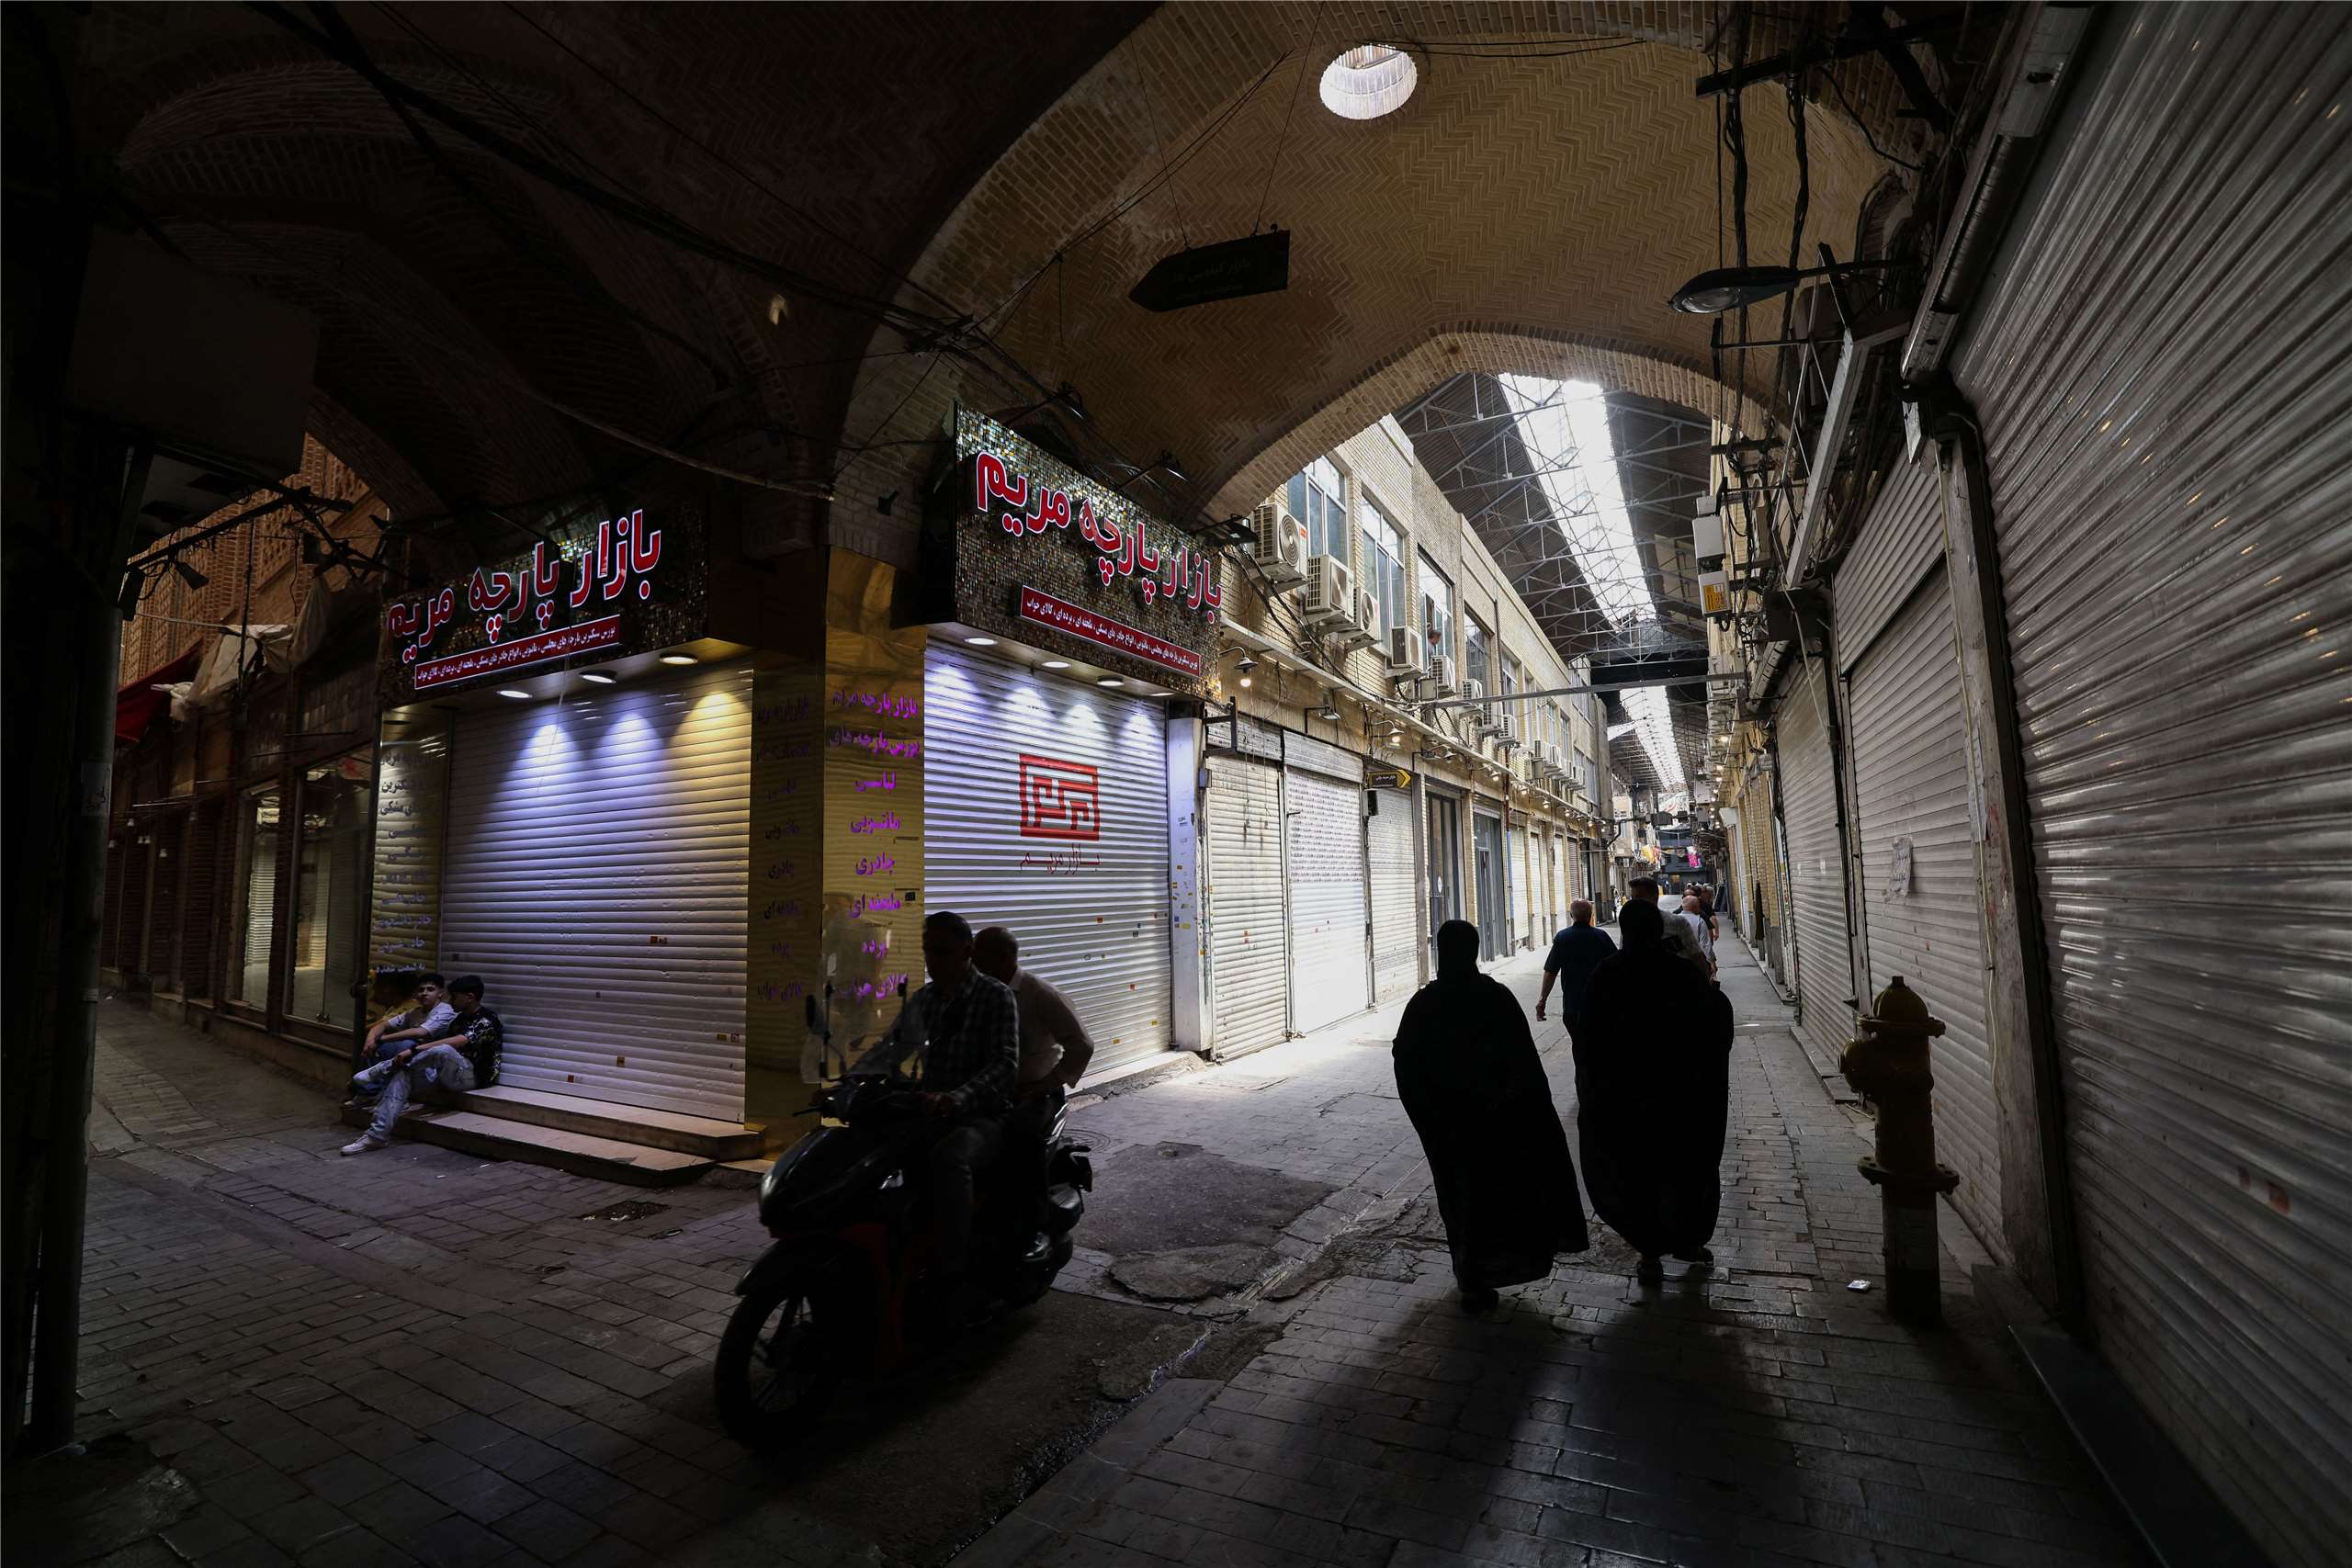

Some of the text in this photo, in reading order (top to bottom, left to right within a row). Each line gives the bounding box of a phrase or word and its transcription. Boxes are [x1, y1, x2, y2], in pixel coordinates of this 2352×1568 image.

[976, 450, 1222, 625] بازار پارچه مریم
[386, 508, 662, 664] بازار پارچه مریم
[893, 694, 919, 719] بازار
[854, 852, 896, 875] چادری
